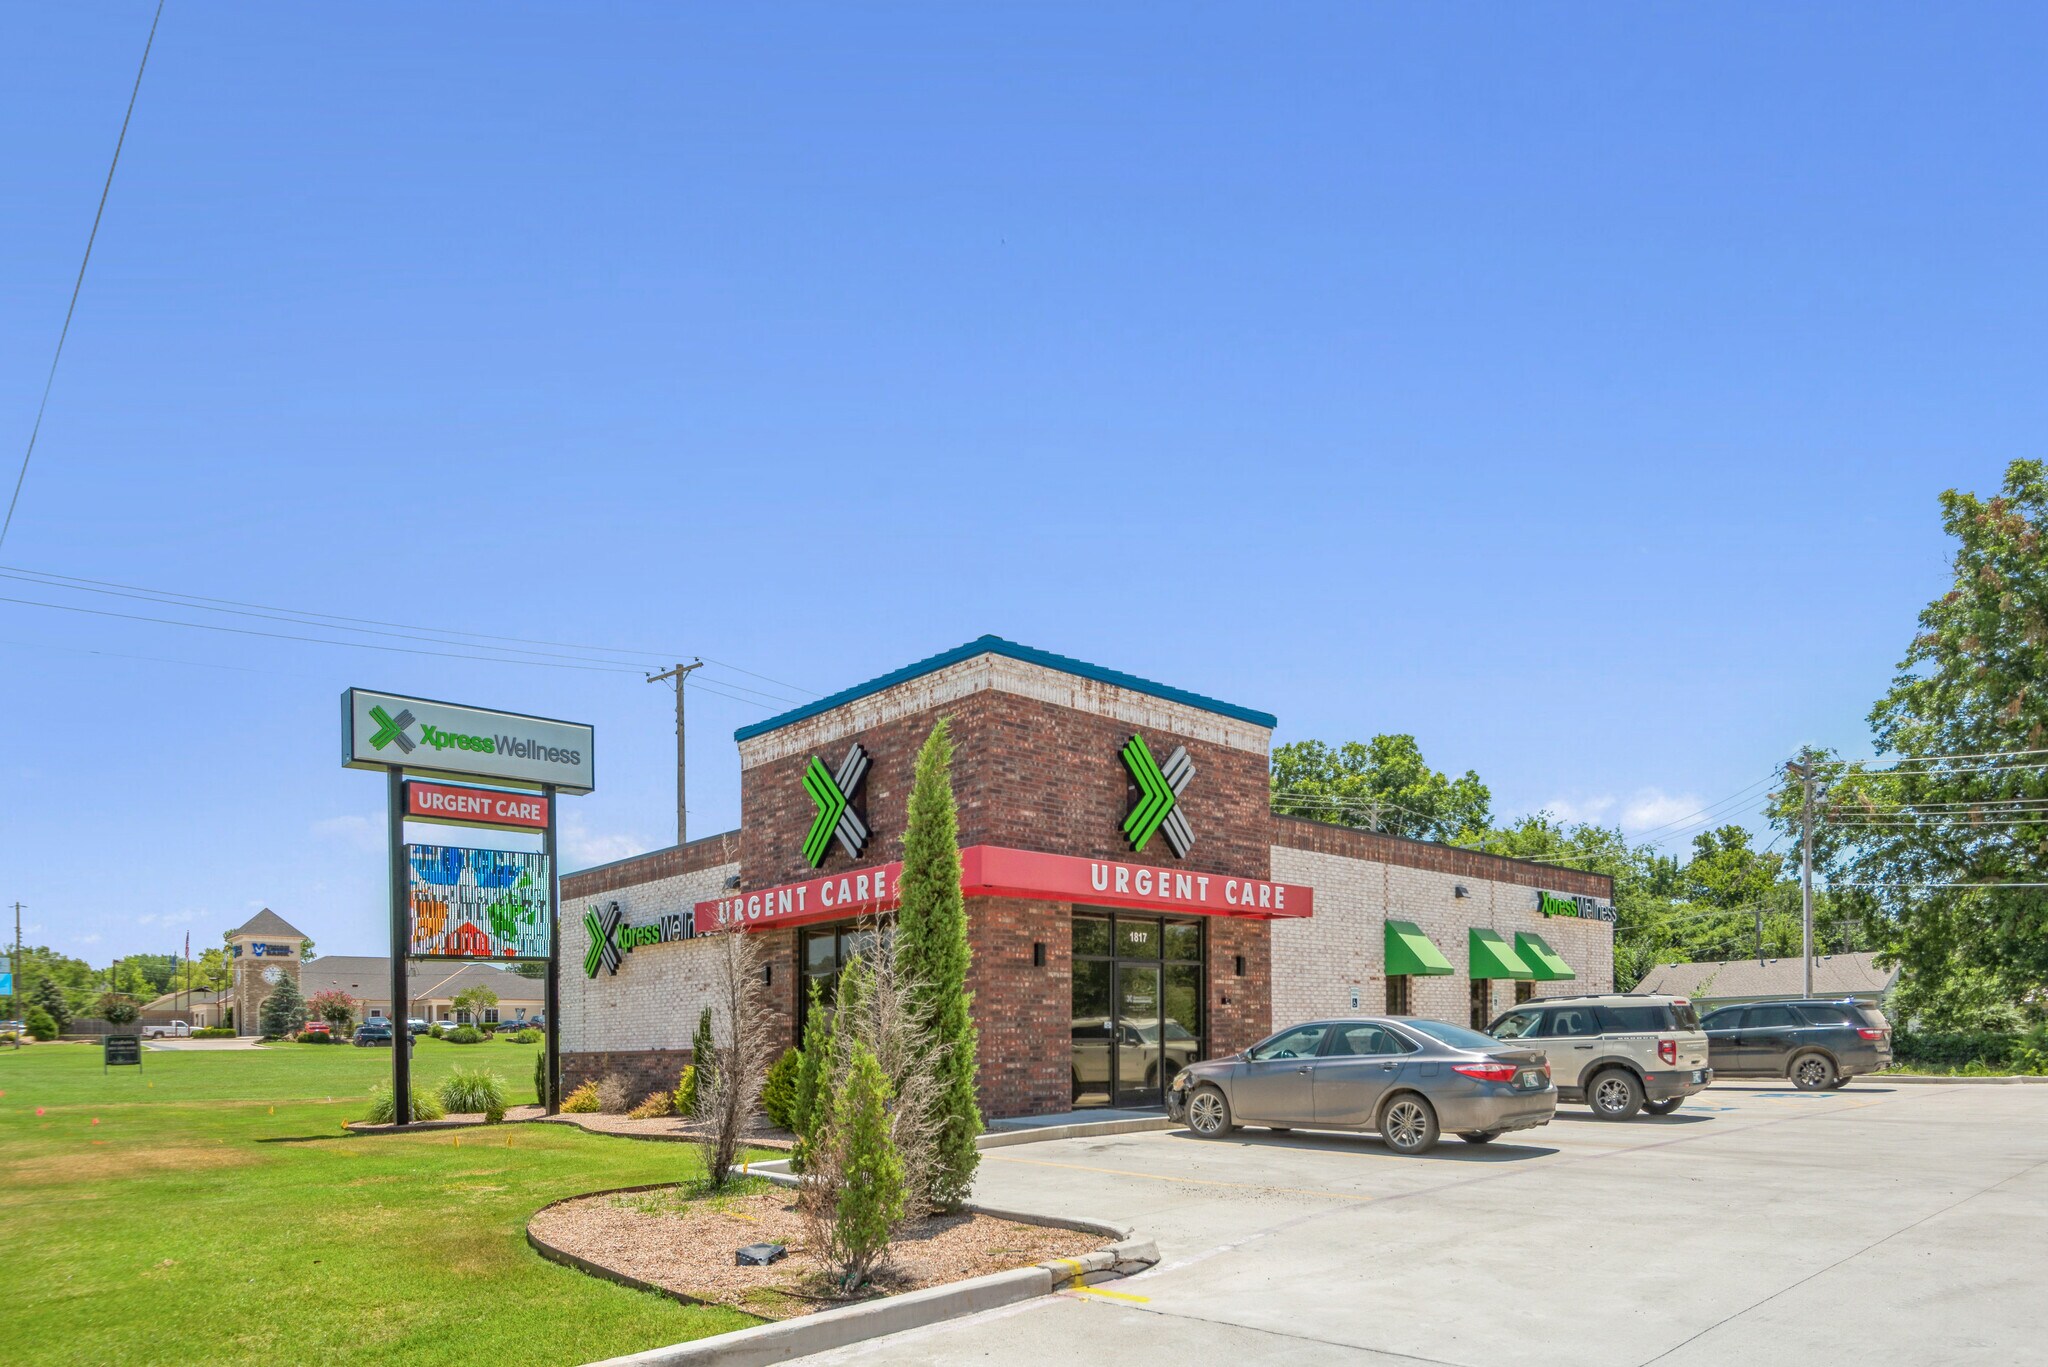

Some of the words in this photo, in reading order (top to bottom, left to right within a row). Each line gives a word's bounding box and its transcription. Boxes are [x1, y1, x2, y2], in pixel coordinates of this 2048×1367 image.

[420, 724, 581, 765] XpressWellness
[418, 791, 492, 815] URGENT
[496, 800, 541, 820] CARE
[718, 886, 807, 924] URGENT
[821, 871, 886, 907] CARE
[1091, 863, 1209, 902] URGENT
[1225, 880, 1285, 910] CARE
[1541, 889, 1617, 922] XpressWellness
[616, 913, 720, 954] XpressWelln
[1129, 931, 1148, 943] 1817
